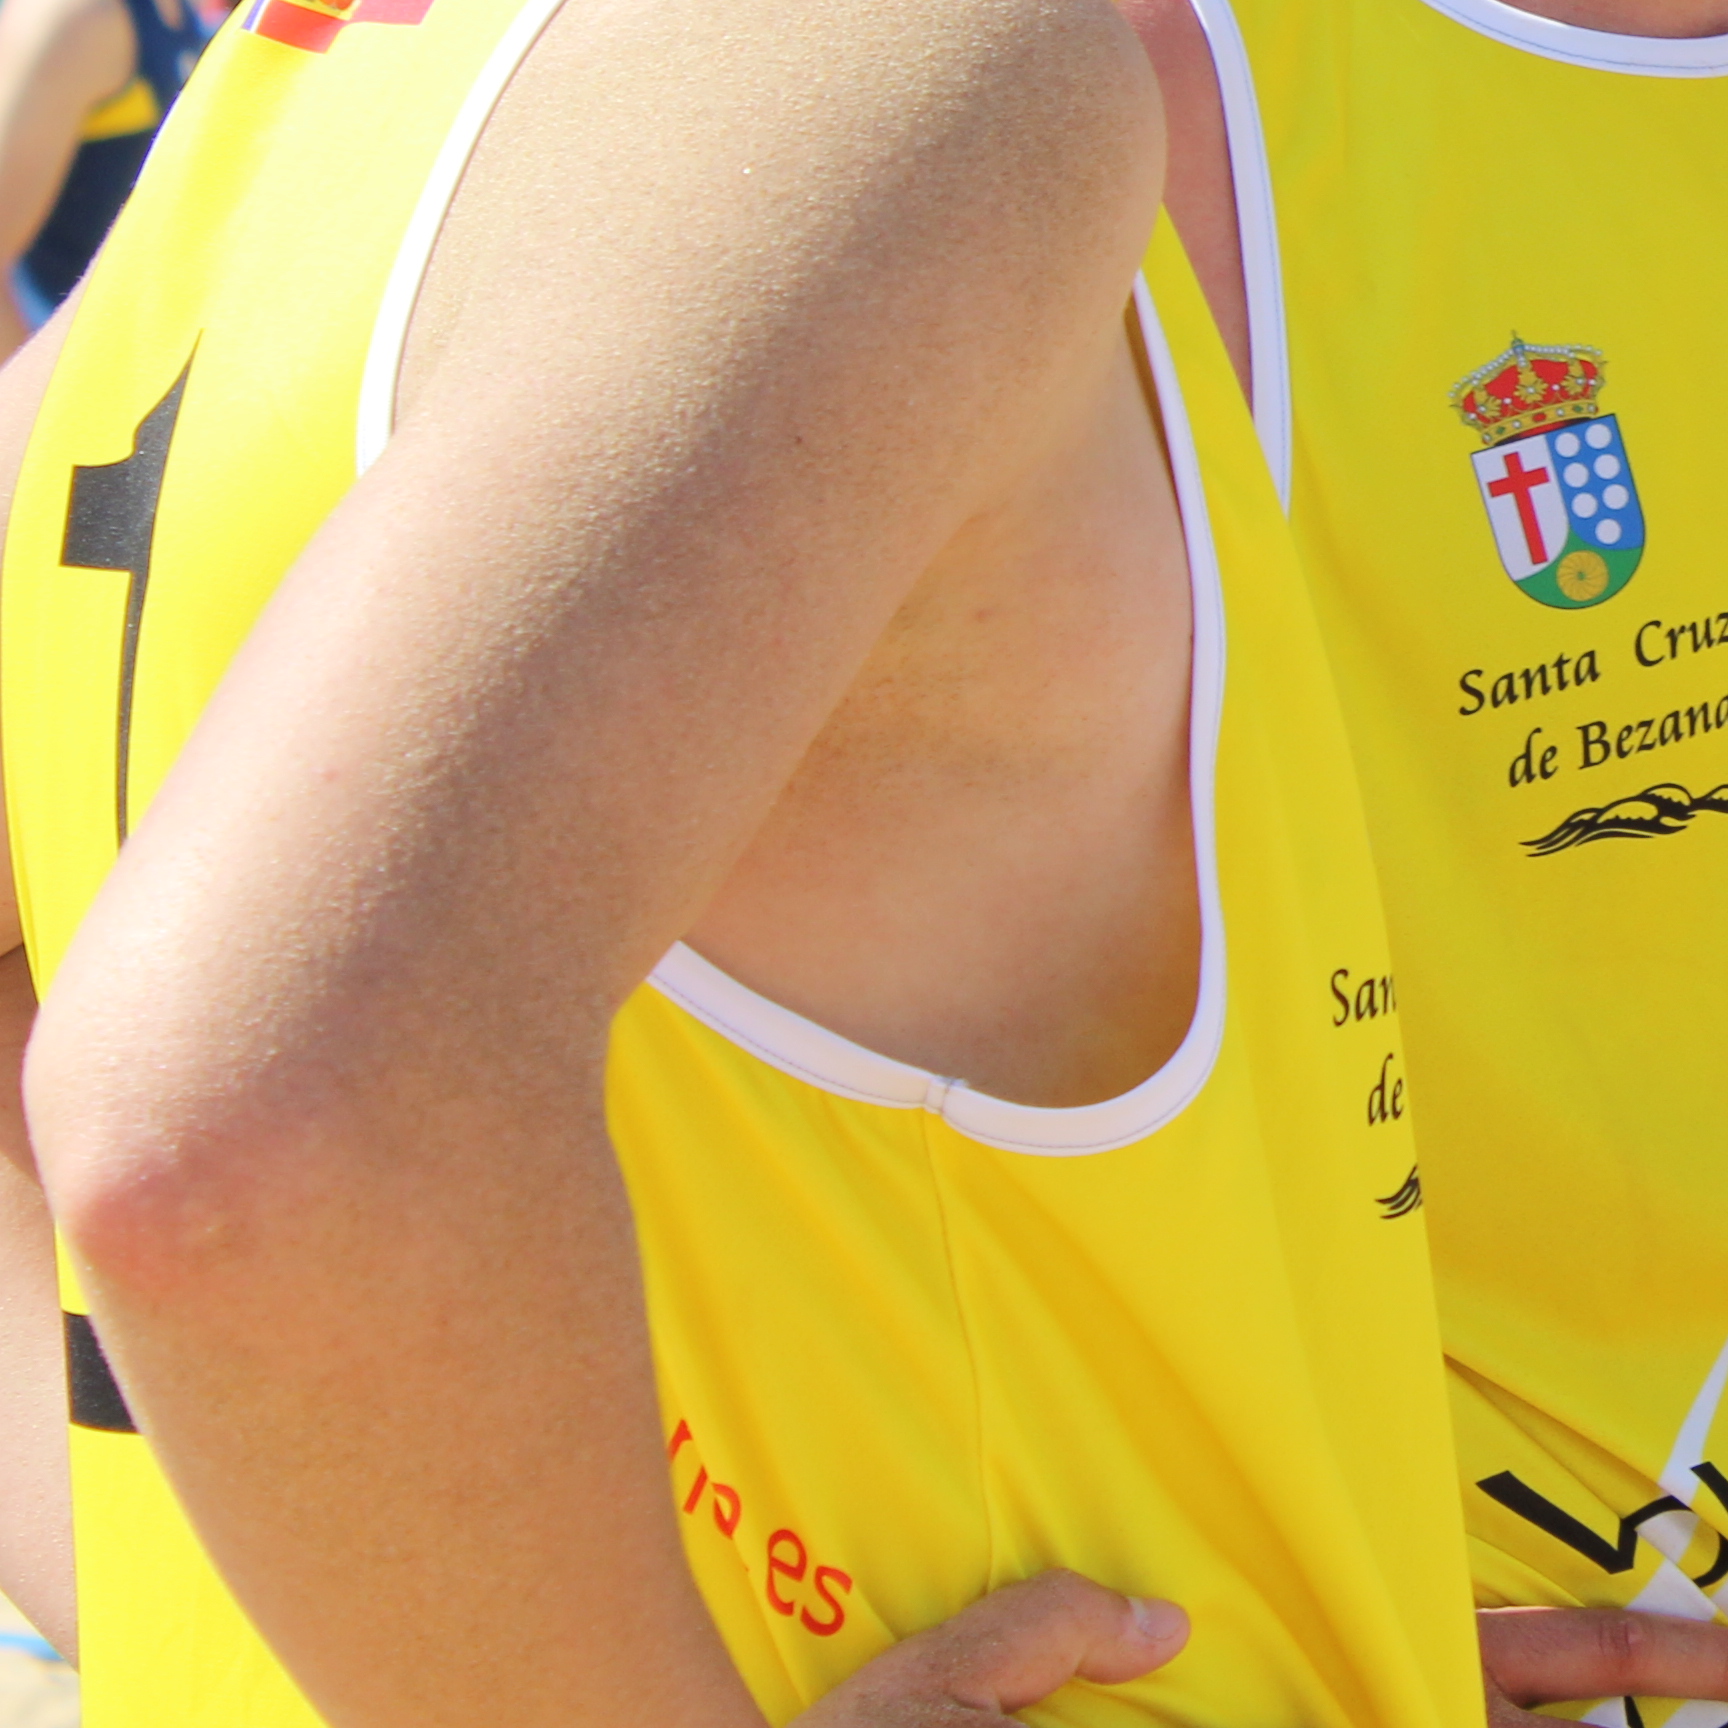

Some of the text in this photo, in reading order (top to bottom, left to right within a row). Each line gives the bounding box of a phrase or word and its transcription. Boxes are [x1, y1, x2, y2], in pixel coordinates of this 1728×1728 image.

[1458, 649, 1601, 716] Santa
[1508, 726, 1559, 788] de
[1367, 1052, 1404, 1127] de
